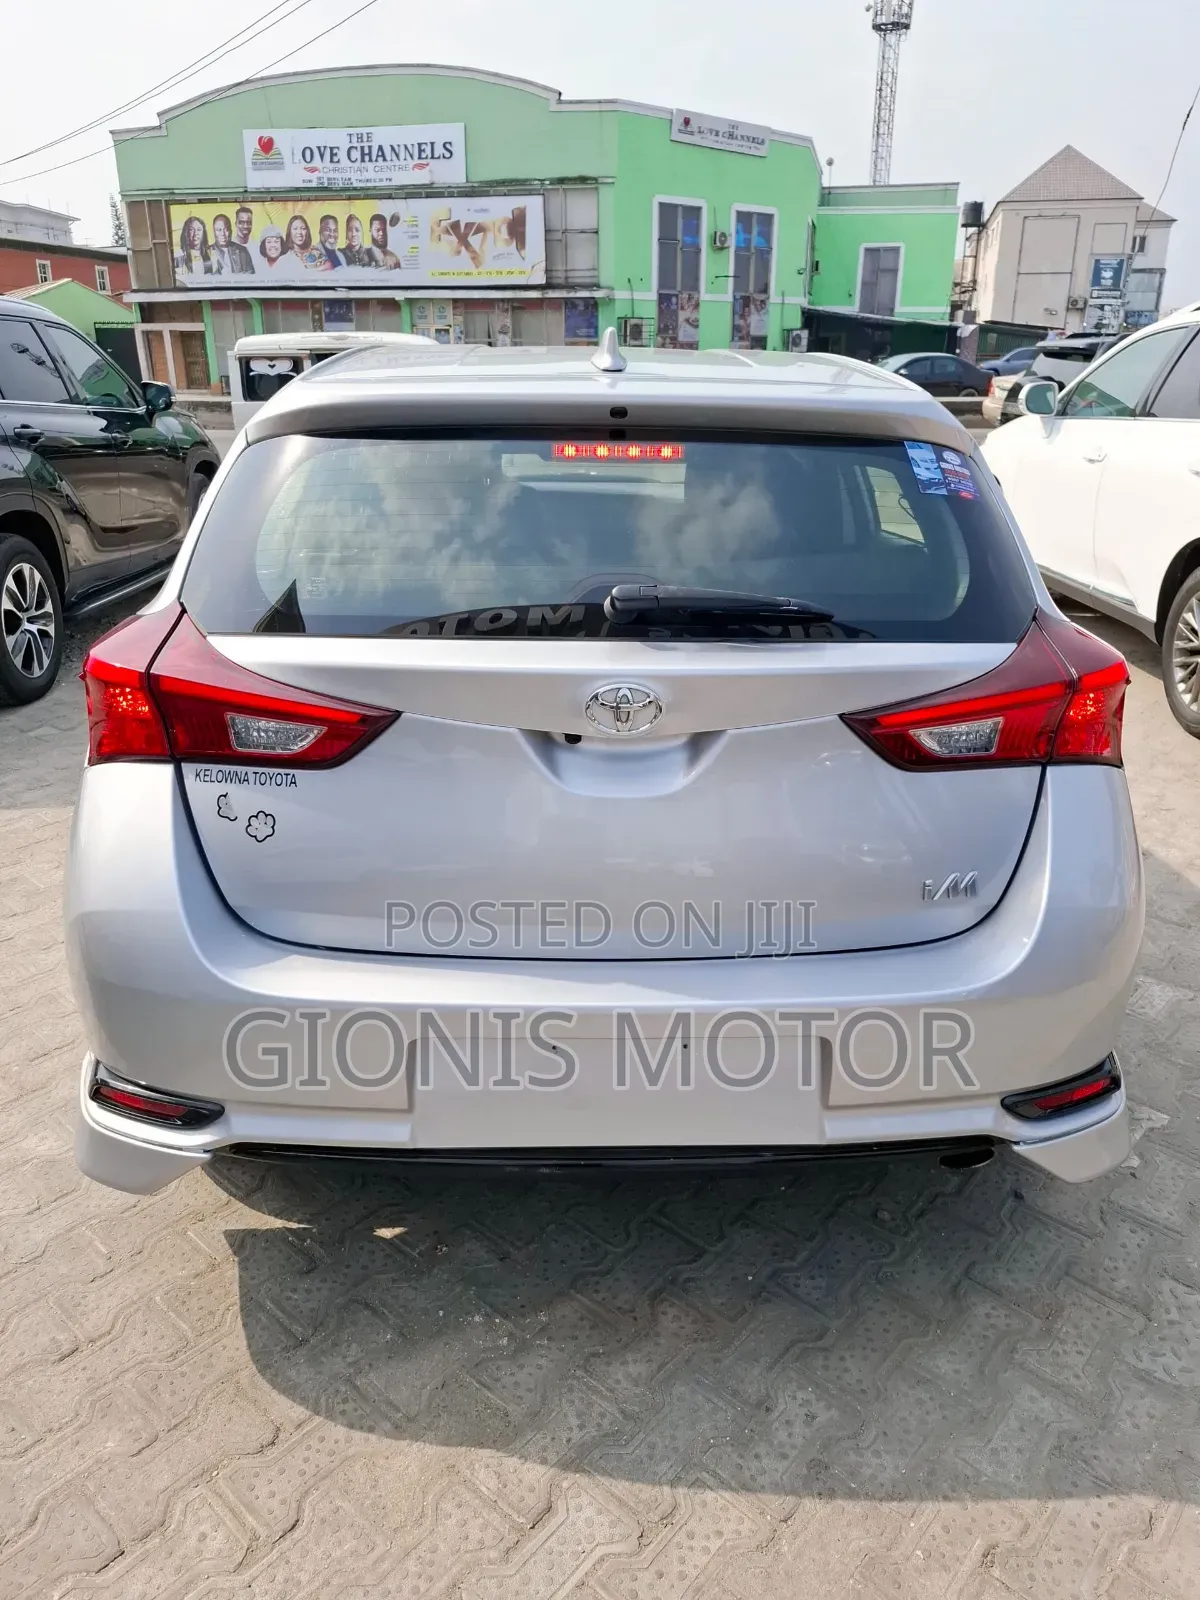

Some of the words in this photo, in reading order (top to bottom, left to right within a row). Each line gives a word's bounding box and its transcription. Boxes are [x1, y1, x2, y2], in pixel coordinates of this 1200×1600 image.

[347, 132, 373, 144] THE
[347, 141, 454, 164] CHANNELS
[322, 165, 369, 175] CHRISTIAN
[374, 164, 411, 173] CENTRE
[195, 768, 250, 785] KELOWNA
[253, 771, 298, 788] TOYOTA
